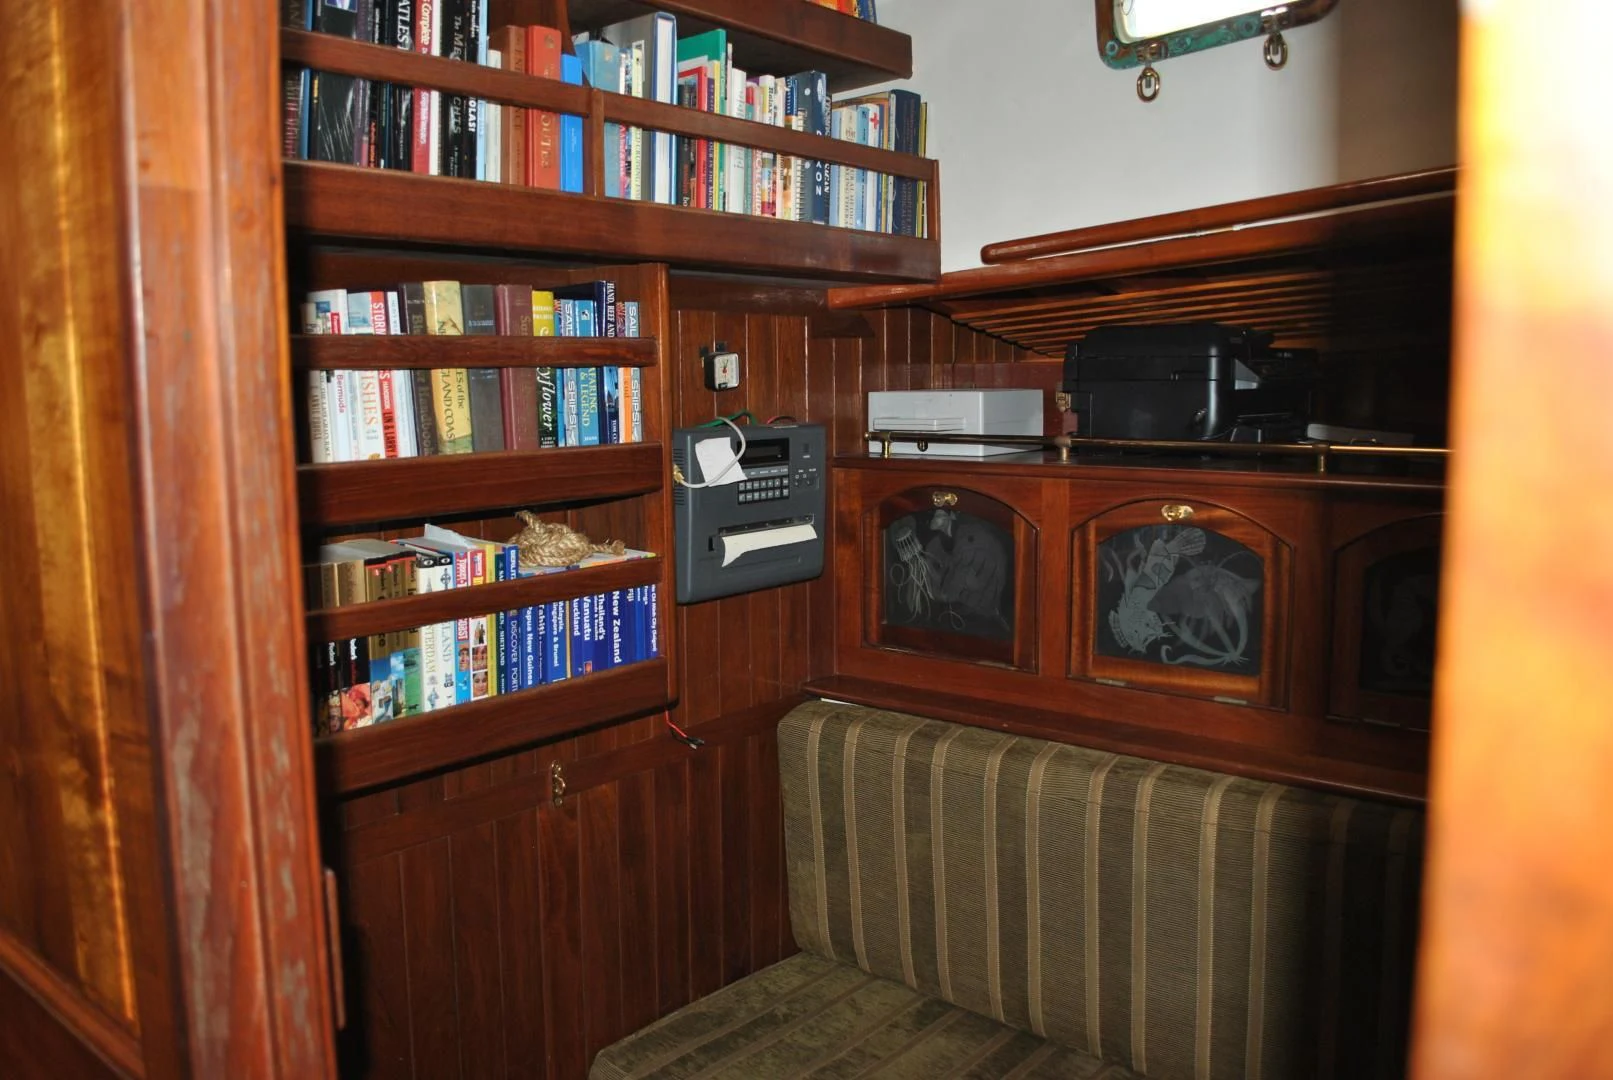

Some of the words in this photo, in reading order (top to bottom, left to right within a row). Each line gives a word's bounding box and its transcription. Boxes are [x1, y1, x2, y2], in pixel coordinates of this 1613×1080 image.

[397, 0, 411, 43] ATLES
[420, 3, 432, 45] Complete
[540, 114, 552, 168] OUTES
[607, 283, 615, 304] HAND,
[629, 306, 637, 337] SAIL
[337, 374, 346, 413] Bermuda
[458, 385, 464, 394] of
[581, 372, 588, 380] &
[589, 367, 597, 414] AFARING
[361, 373, 379, 425] ISHES
[383, 412, 394, 424] LIN
[581, 384, 590, 426] LEGEND
[385, 432, 396, 453] LARRY
[583, 596, 591, 641] Vanuatu
[424, 625, 436, 673] STERDAM
[613, 619, 621, 663] Zealand
